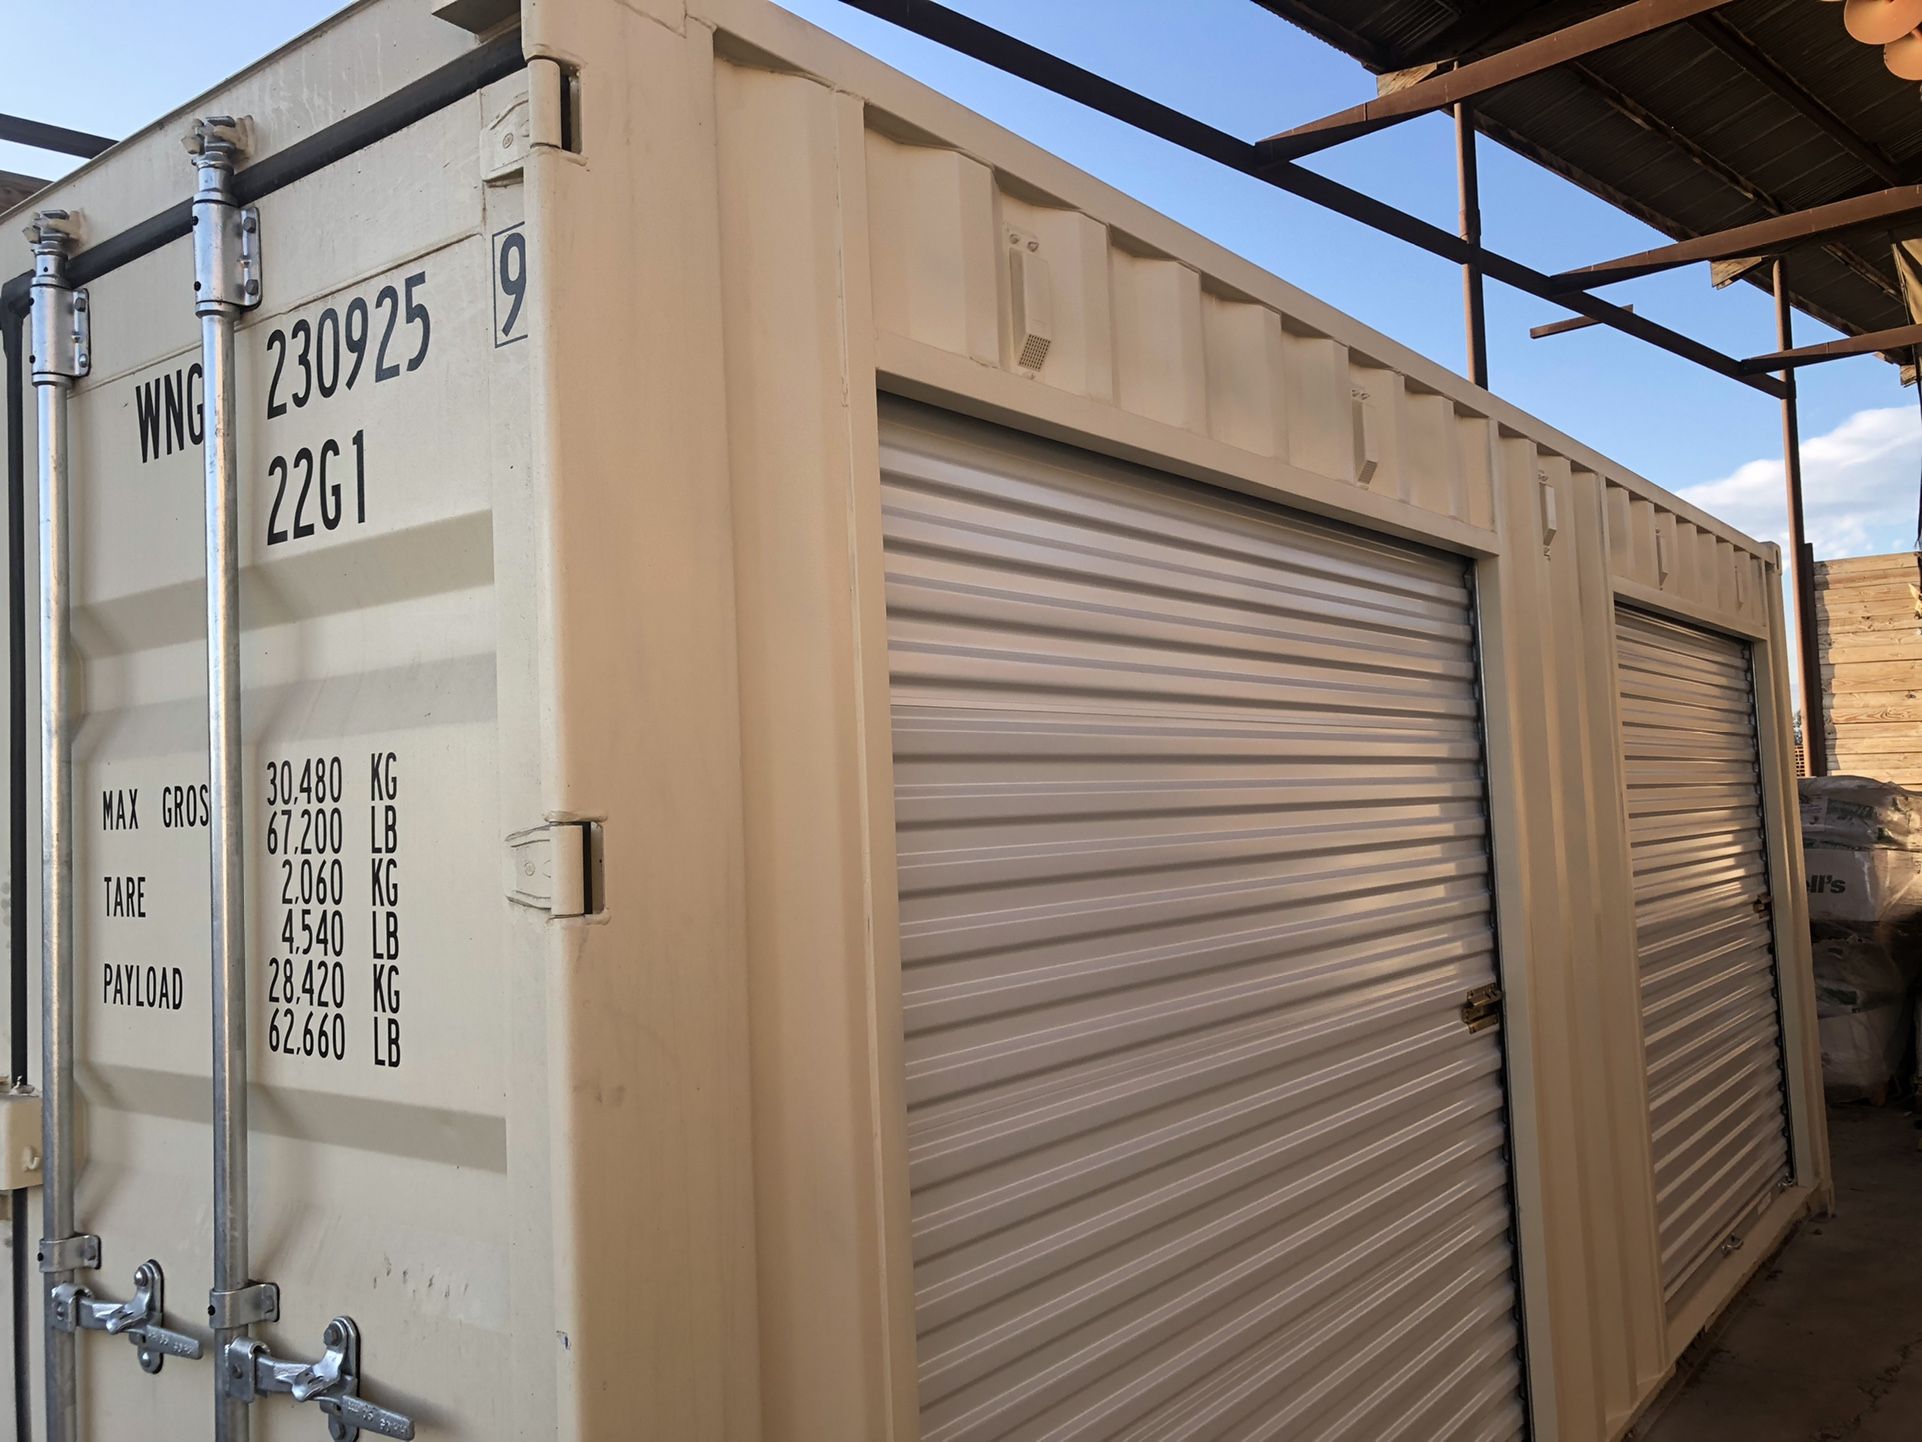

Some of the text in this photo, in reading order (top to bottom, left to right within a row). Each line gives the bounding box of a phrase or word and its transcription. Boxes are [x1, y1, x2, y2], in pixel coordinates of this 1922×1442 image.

[136, 232, 527, 463] WNG 230925 9
[267, 429, 366, 545] 22G1
[103, 752, 397, 830] MAX GROS 30,480 KG
[267, 805, 397, 855] 67,200 LB
[104, 857, 398, 918] TARE 2,060 KG
[282, 908, 399, 960] 4,540 LB
[104, 957, 400, 1014] PAYLOAD 28,420 KG
[269, 1007, 401, 1068] 62,660 LB
